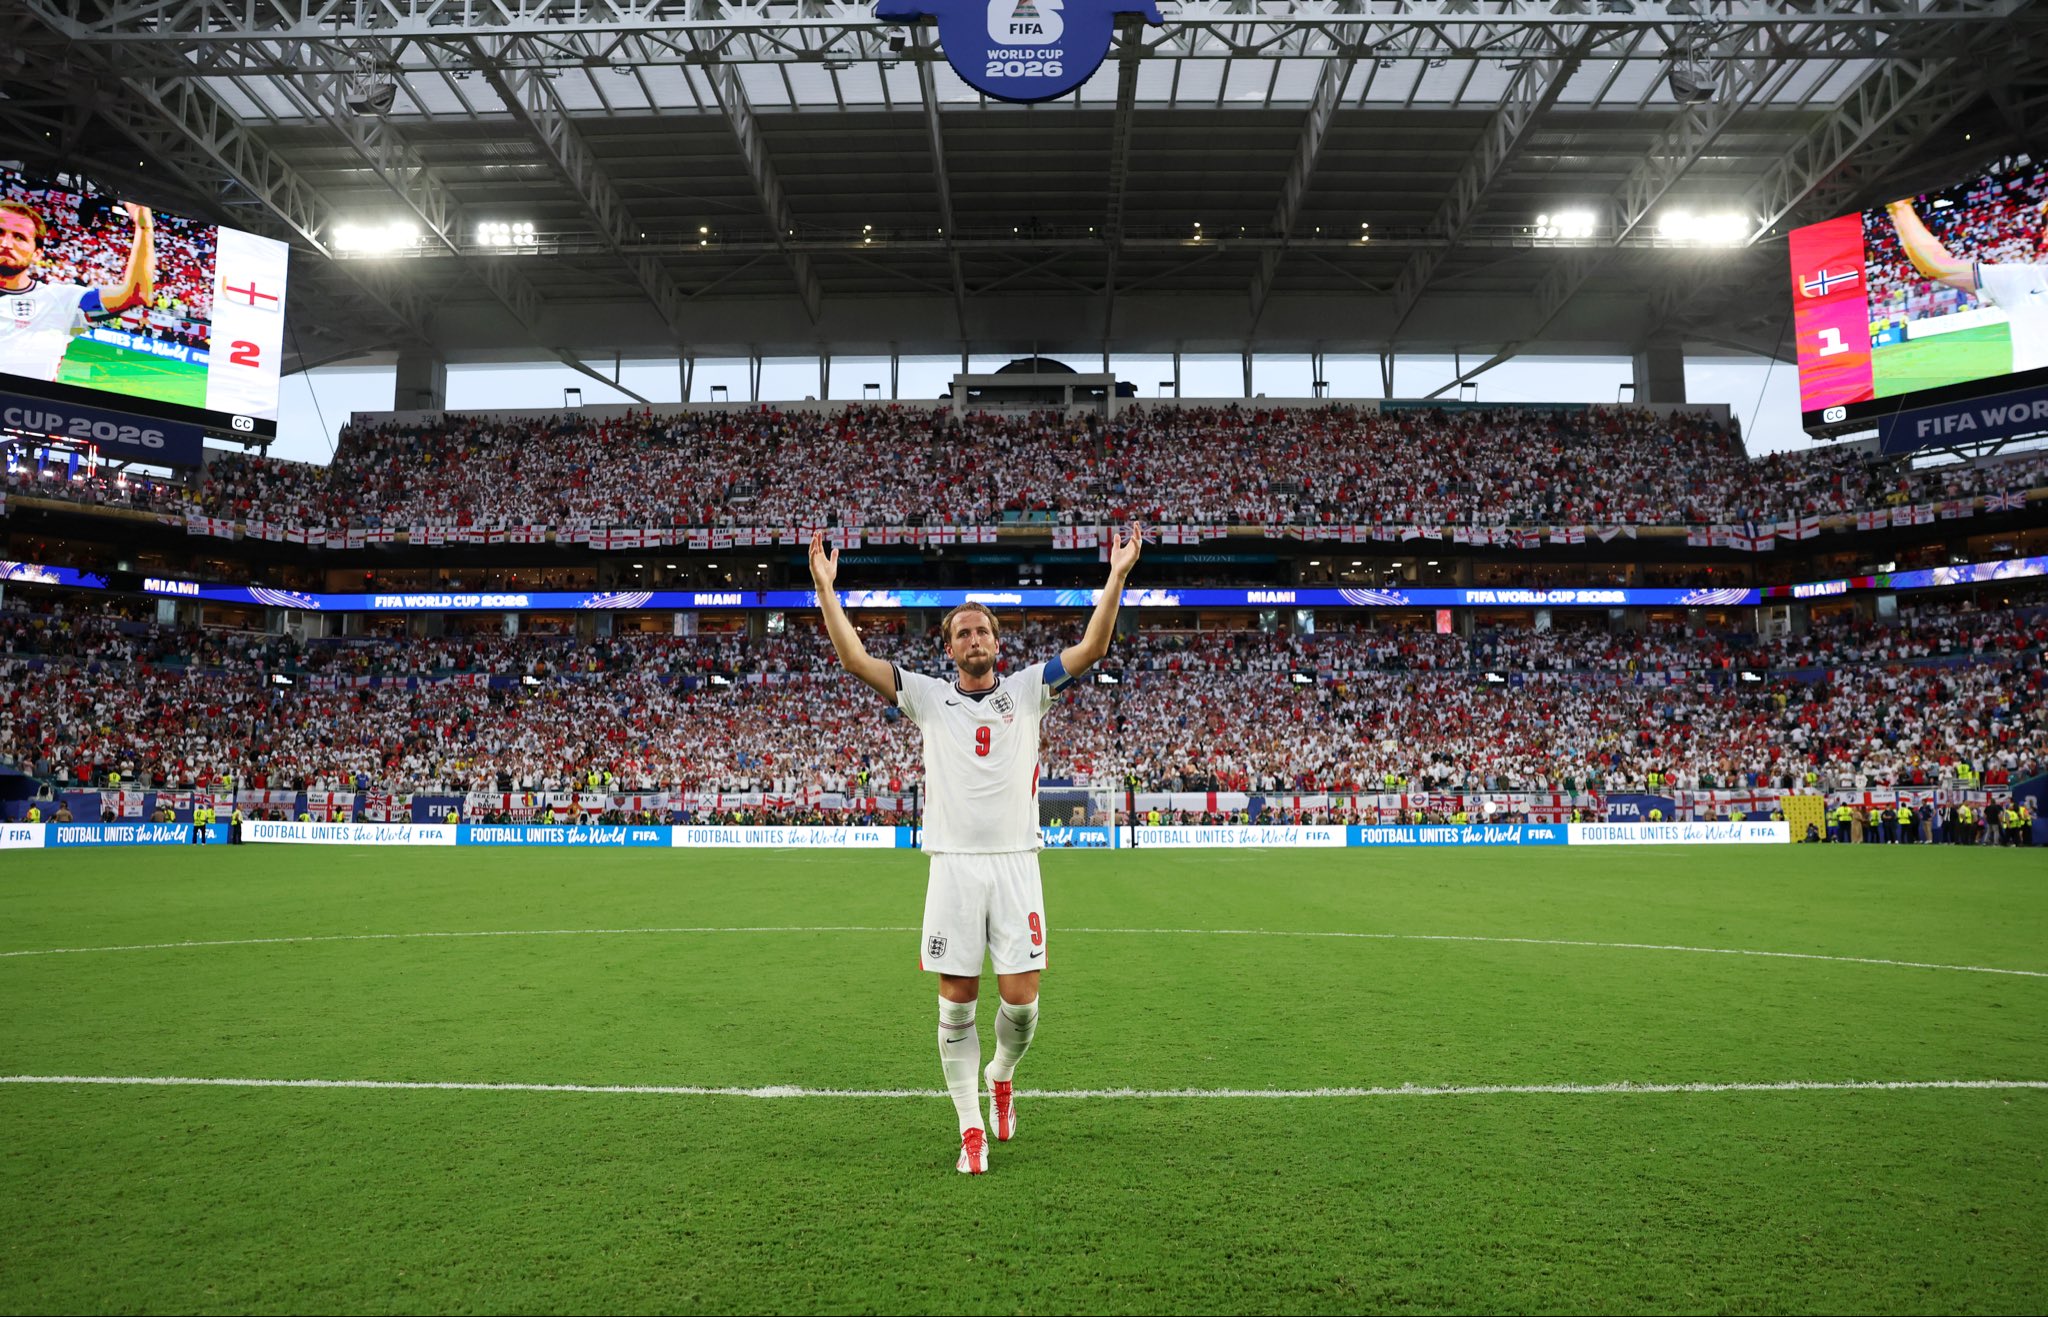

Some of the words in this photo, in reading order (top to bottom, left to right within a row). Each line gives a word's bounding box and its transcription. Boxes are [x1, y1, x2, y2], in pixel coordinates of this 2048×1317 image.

[1009, 23, 1043, 35] FIFA
[987, 50, 1034, 60] WORLD
[1039, 49, 1063, 60] CUP
[986, 61, 1063, 77] 2026
[1818, 328, 1849, 356] 1
[230, 340, 260, 368] 2
[1826, 409, 1843, 421] CC
[4, 407, 63, 431] CUP
[68, 417, 164, 448] 2026
[234, 418, 251, 430] CC
[1917, 412, 1978, 438] FIFA
[144, 578, 199, 596] MIAMI
[1794, 581, 1847, 598] MIAMI
[375, 596, 403, 607] FIFA
[403, 596, 452, 607] WORLD
[453, 595, 480, 607] CUP
[694, 593, 742, 605] MIAMI
[1248, 591, 1295, 603] MIAMI
[1466, 591, 1496, 602] FIFA
[1497, 590, 1547, 602] WORLD
[1548, 591, 1576, 602] CUP
[975, 726, 991, 757] 9
[1608, 803, 1640, 816] FIFA
[9, 830, 31, 841] FIFA
[57, 826, 101, 843] FOOTBALL
[104, 826, 134, 842] UNITES
[135, 823, 151, 843] the
[153, 824, 188, 843] World
[254, 824, 307, 840] FOOTBALL
[311, 825, 349, 840] UNITES
[353, 825, 373, 841] the
[375, 826, 412, 843] World
[419, 830, 443, 839] FIFA
[470, 827, 523, 843] FOOTBALL
[527, 827, 564, 843] UNITES
[566, 826, 587, 844] the
[589, 826, 627, 845] World
[633, 831, 658, 841] FIFA
[688, 829, 741, 844] FOOTBALL
[746, 830, 783, 844] UNITES
[788, 829, 808, 844] the
[810, 829, 846, 845] World
[855, 832, 879, 841] FIFA
[1080, 832, 1105, 842] FIFA
[1137, 830, 1191, 844] FOOTBALL
[1195, 830, 1236, 843] UNITES
[1239, 828, 1258, 844] the
[1261, 828, 1297, 844] World
[1306, 832, 1331, 841] FIFA
[1361, 828, 1416, 843] FOOTBALL
[1419, 828, 1458, 843] UNITES
[1461, 826, 1482, 843] the
[1484, 825, 1522, 844] World
[1528, 829, 1553, 840] FIFA
[1582, 827, 1636, 841] FOOTBALL
[1640, 826, 1678, 840] UNITES
[1682, 824, 1703, 841] the
[1704, 823, 1743, 841] World
[1750, 827, 1775, 837] FIFA
[1028, 912, 1042, 946] 9
